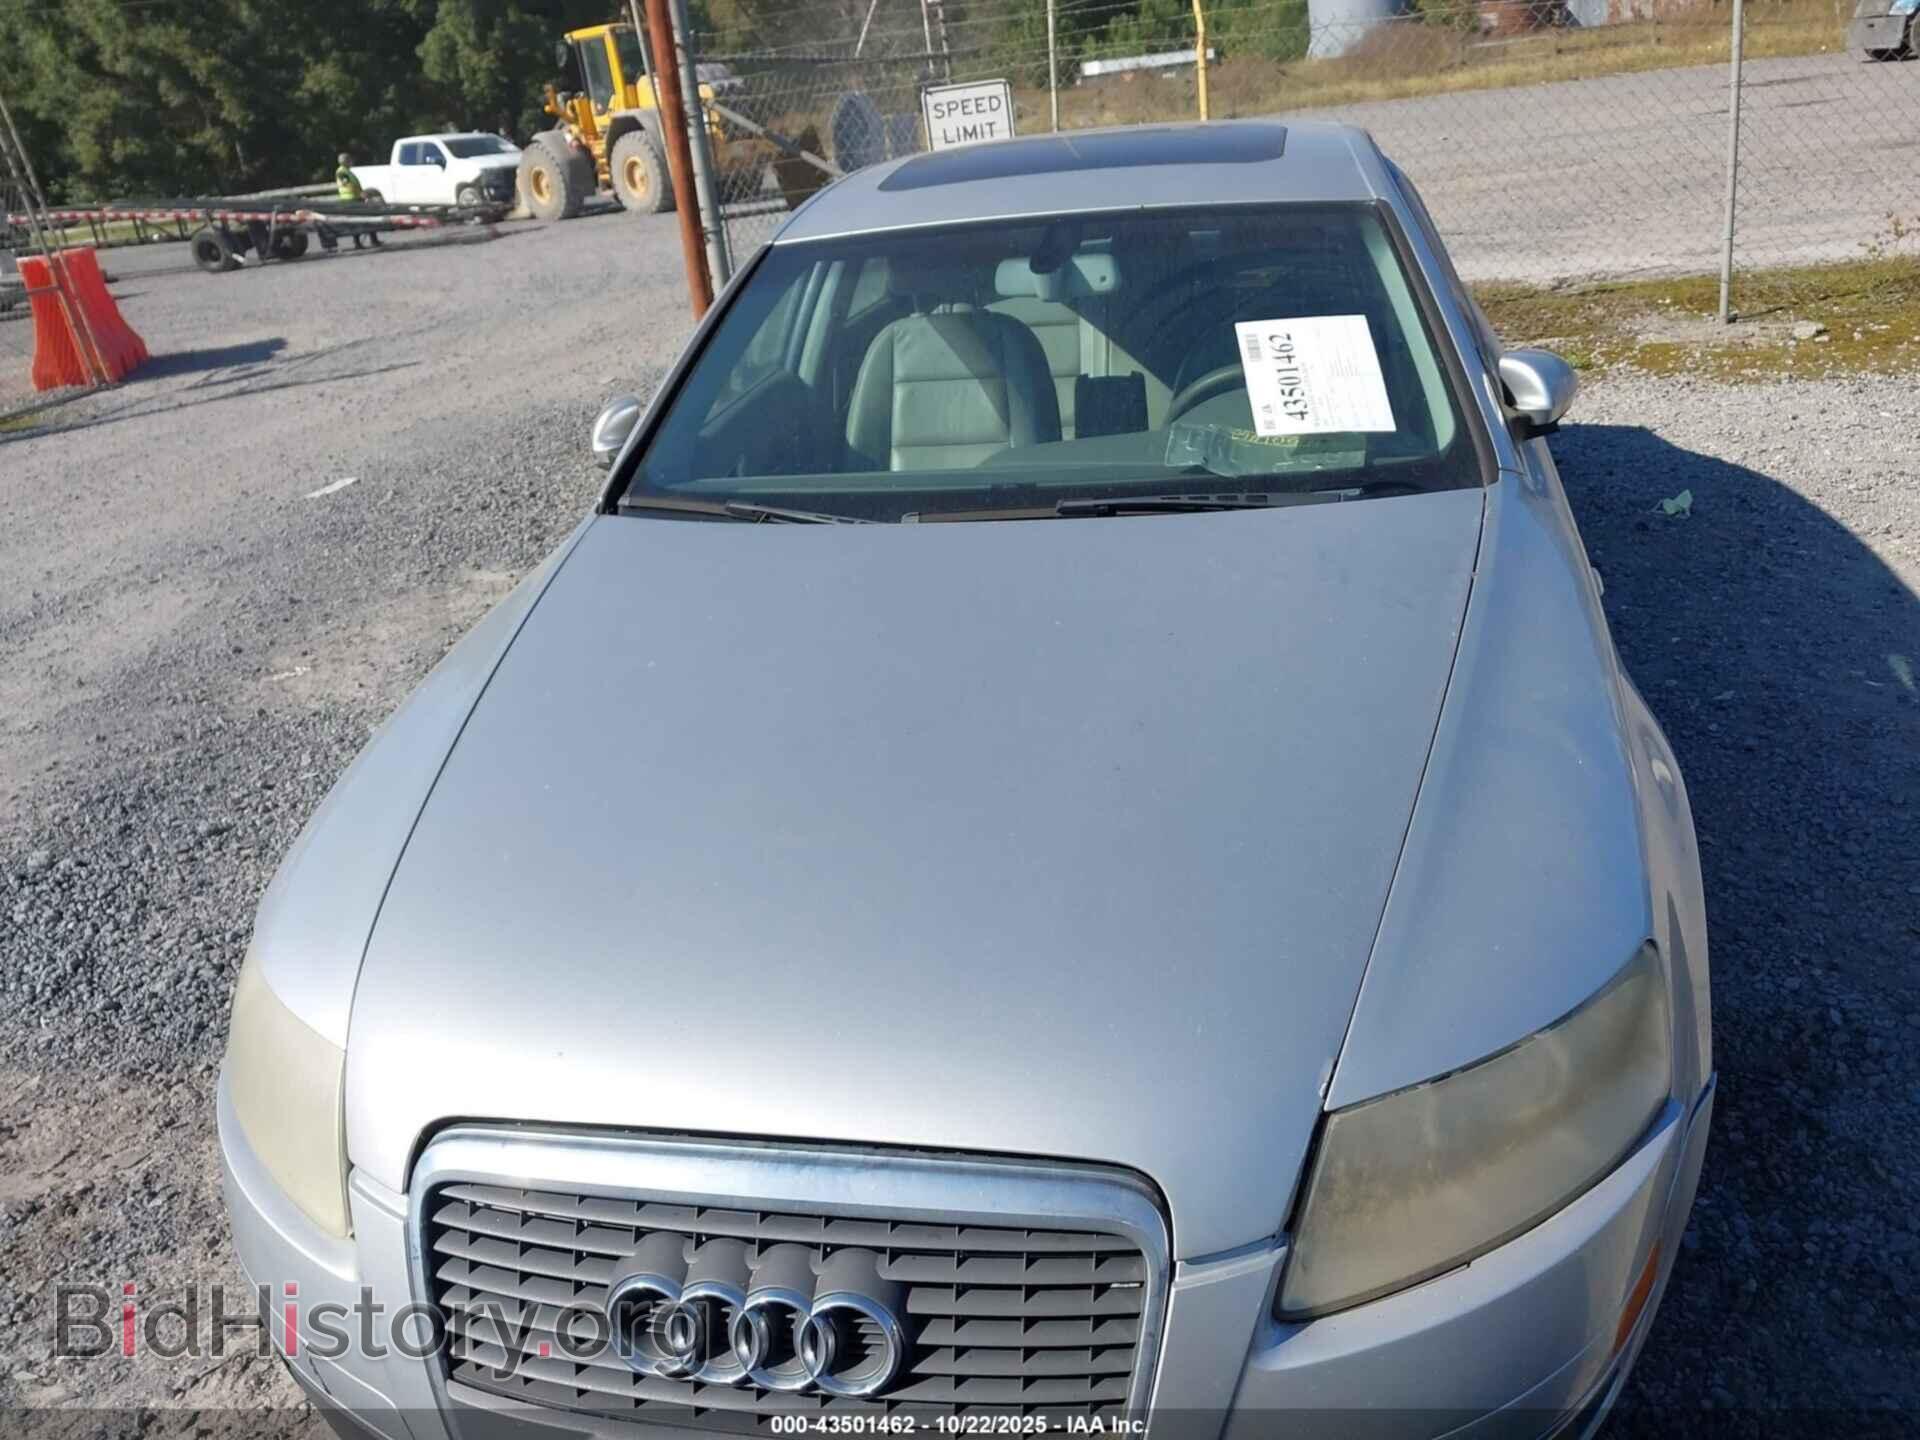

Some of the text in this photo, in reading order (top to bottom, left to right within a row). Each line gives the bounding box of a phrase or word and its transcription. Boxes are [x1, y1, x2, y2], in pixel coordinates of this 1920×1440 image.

[933, 95, 1002, 120] SPEED
[942, 121, 997, 144] LIMIT
[1268, 333, 1309, 421] 43501462
